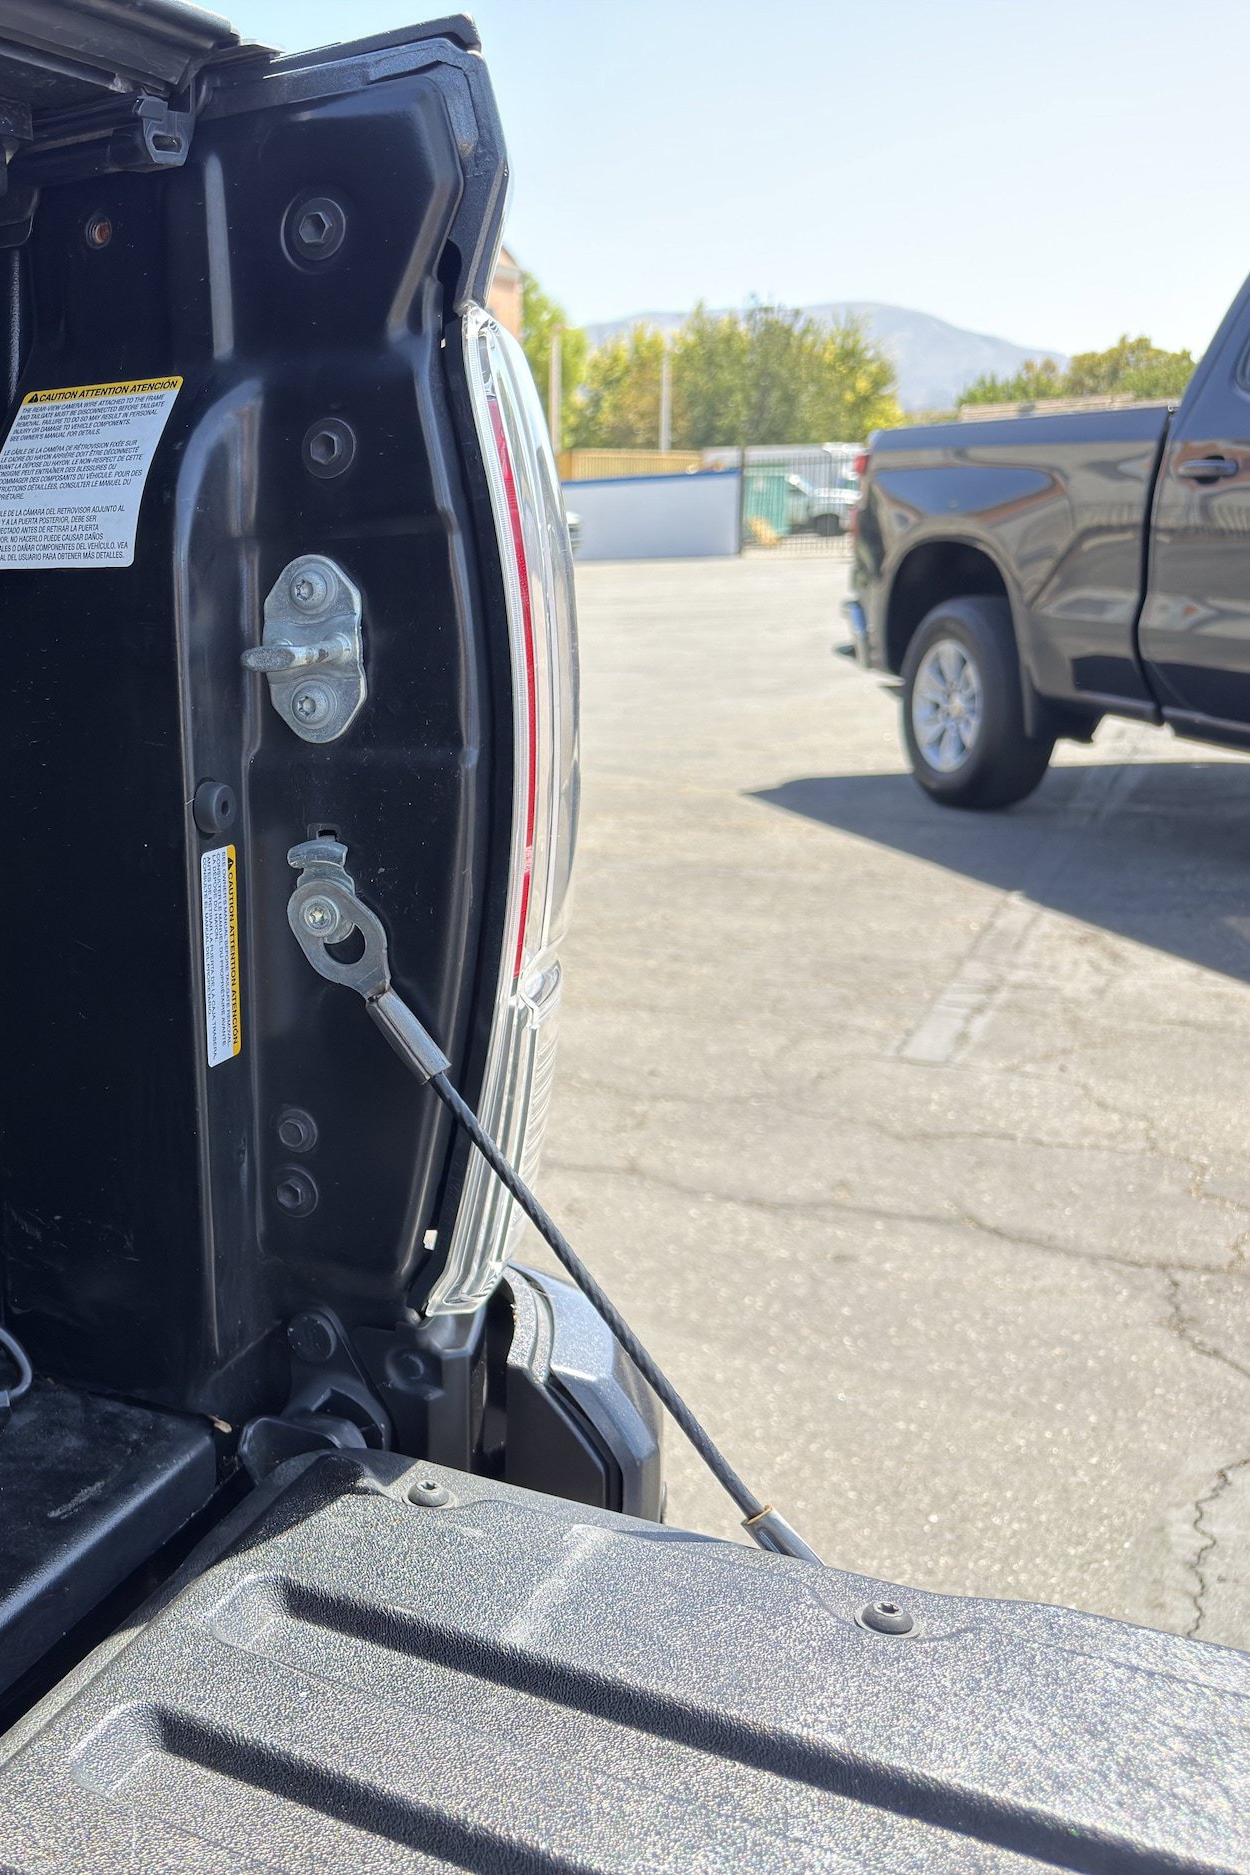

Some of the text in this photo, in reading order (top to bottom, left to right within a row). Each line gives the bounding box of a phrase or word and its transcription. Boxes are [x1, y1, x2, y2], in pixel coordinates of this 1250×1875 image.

[39, 379, 179, 401] CAUTION ATTENTION ATENCIÓN
[30, 412, 54, 420] TAILGATE
[77, 406, 118, 415] DISCONNECTED
[139, 401, 165, 409] TAILGATE
[32, 405, 61, 413] REAR-VIEW
[60, 402, 84, 410] CAMERA
[98, 398, 126, 406] ATTACHED
[128, 409, 159, 417] PERSONAL
[70, 422, 93, 430] VEHICLE
